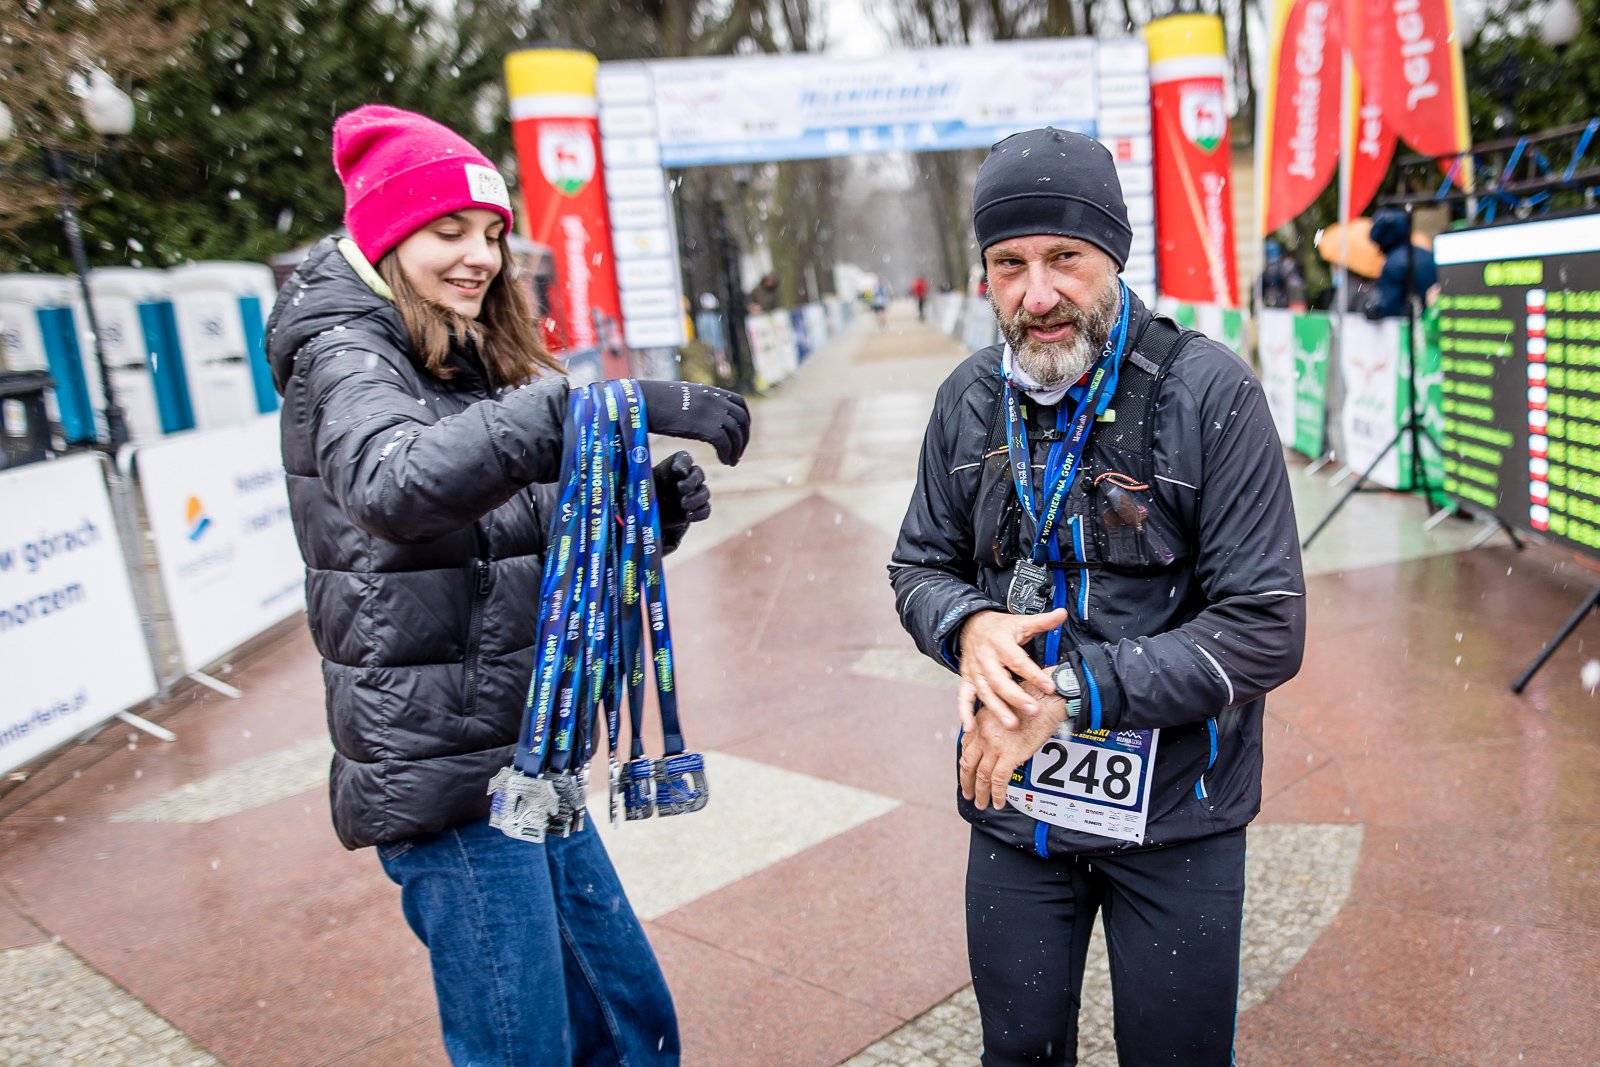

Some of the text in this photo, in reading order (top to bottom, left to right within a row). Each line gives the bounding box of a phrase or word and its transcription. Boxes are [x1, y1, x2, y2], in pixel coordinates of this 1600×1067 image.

[592, 456, 603, 506] WIDOKIEM
[1060, 451, 1074, 477] GÓRY
[1056, 478, 1066, 491] NA
[591, 518, 602, 540] BIEG
[1042, 492, 1061, 537] WIDOKIEM
[23, 518, 101, 574] górach
[590, 552, 600, 588] RUNNERS
[1036, 742, 1132, 800] 248
